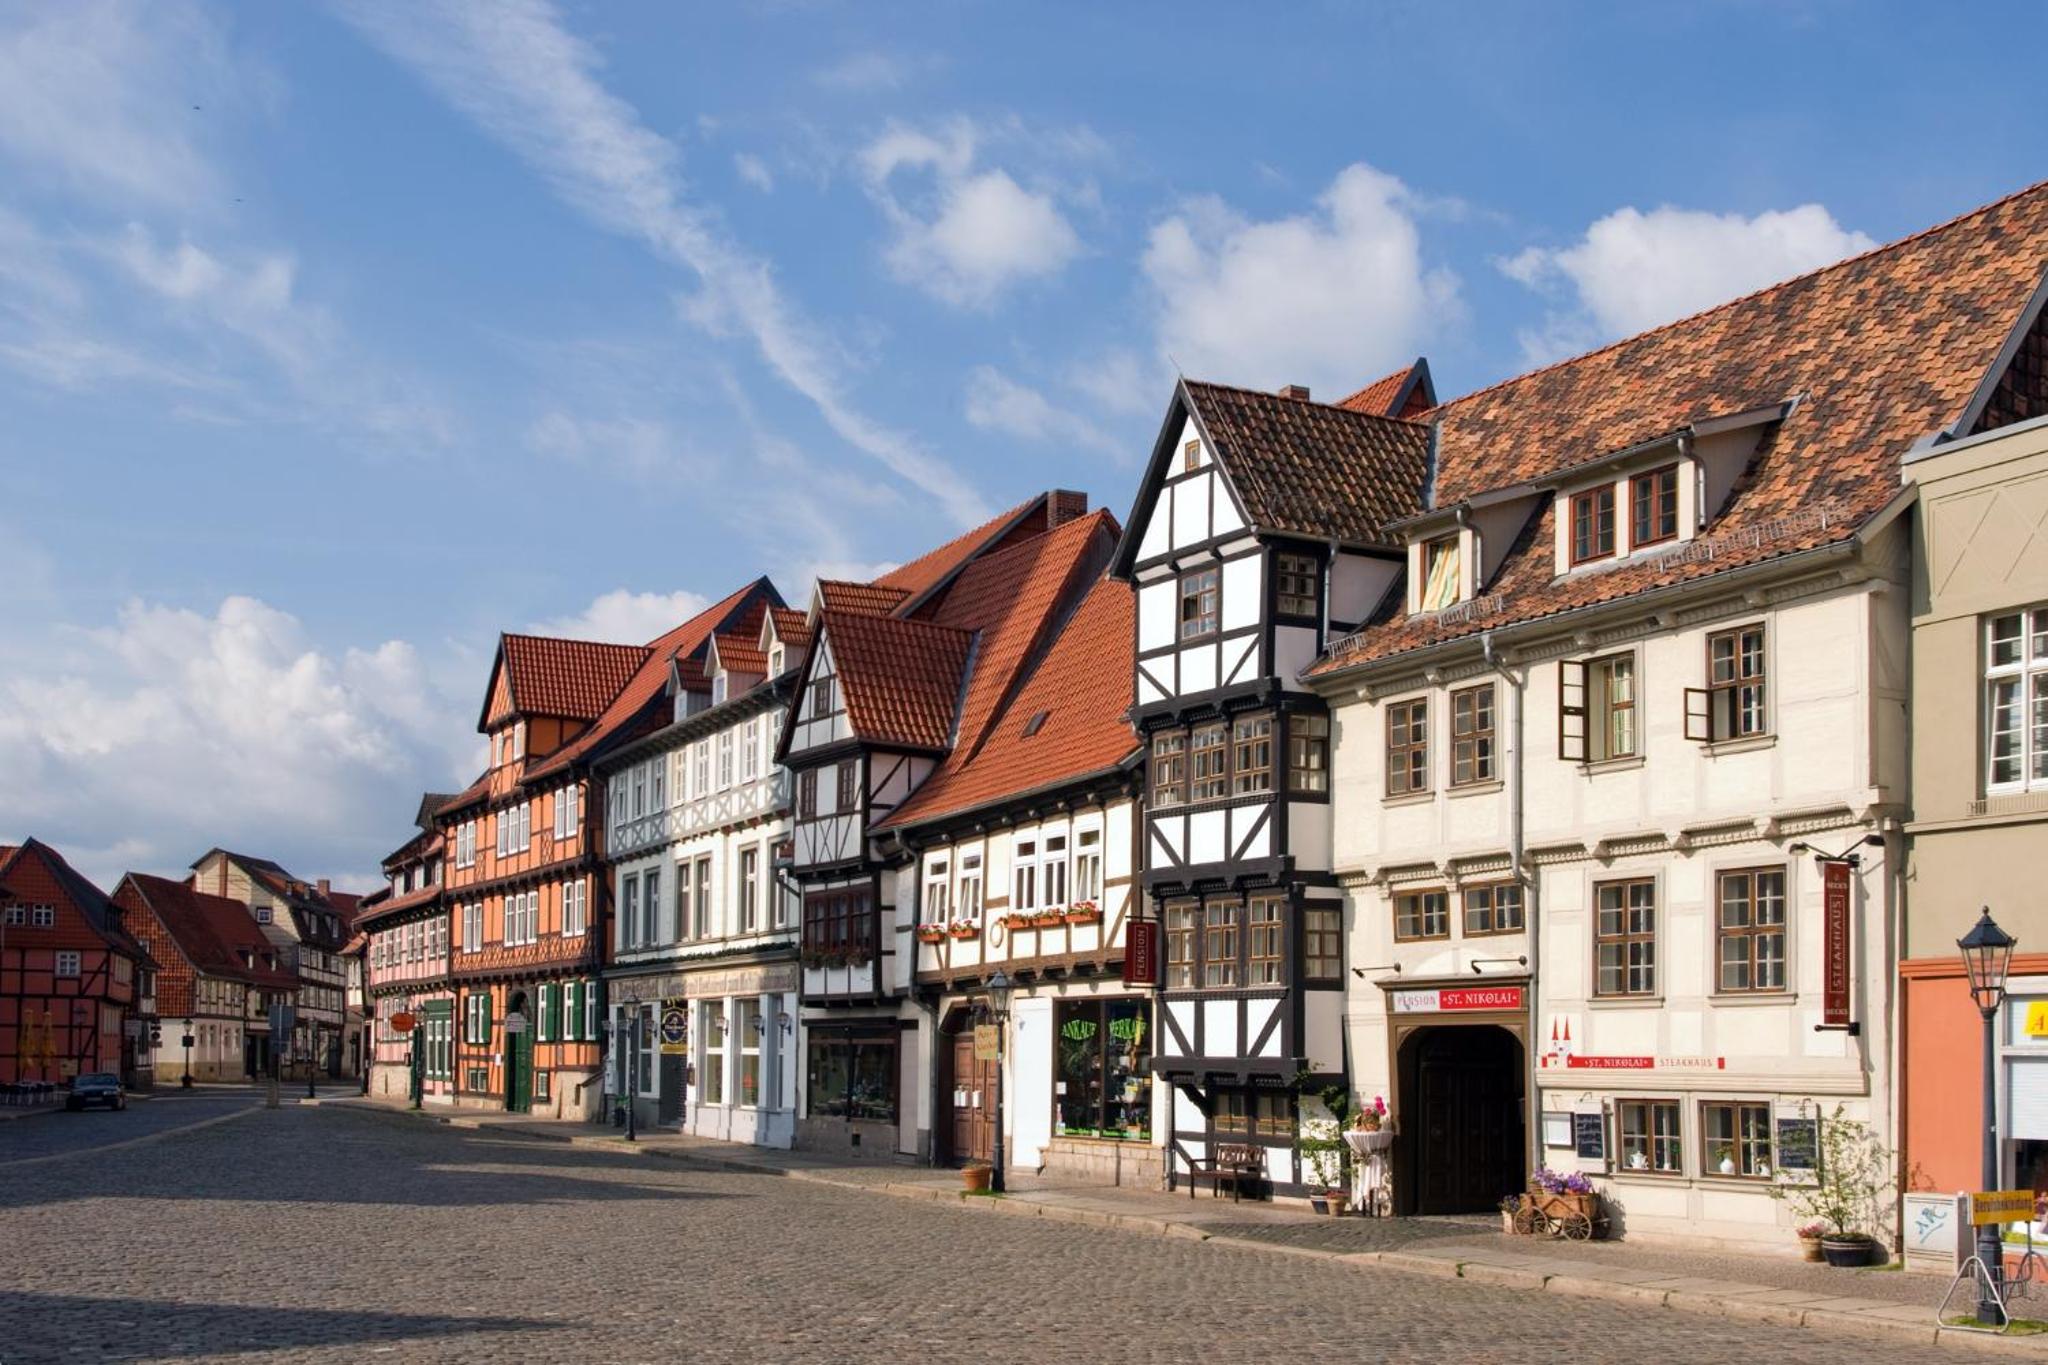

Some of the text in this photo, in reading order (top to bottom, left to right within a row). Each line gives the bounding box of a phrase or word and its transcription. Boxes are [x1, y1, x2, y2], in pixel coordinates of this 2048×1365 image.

[1136, 929, 1146, 976] PENSION
[1832, 900, 1842, 988] STEAKHAUS
[1447, 993, 1463, 1006] ST.
[1465, 992, 1512, 1005] NIKOLAI
[1062, 1020, 1097, 1040] ANKAUF
[1109, 1018, 1147, 1039] VERKAF
[1588, 1057, 1713, 1068] ST. NIKOLAI STEAKHAUS
